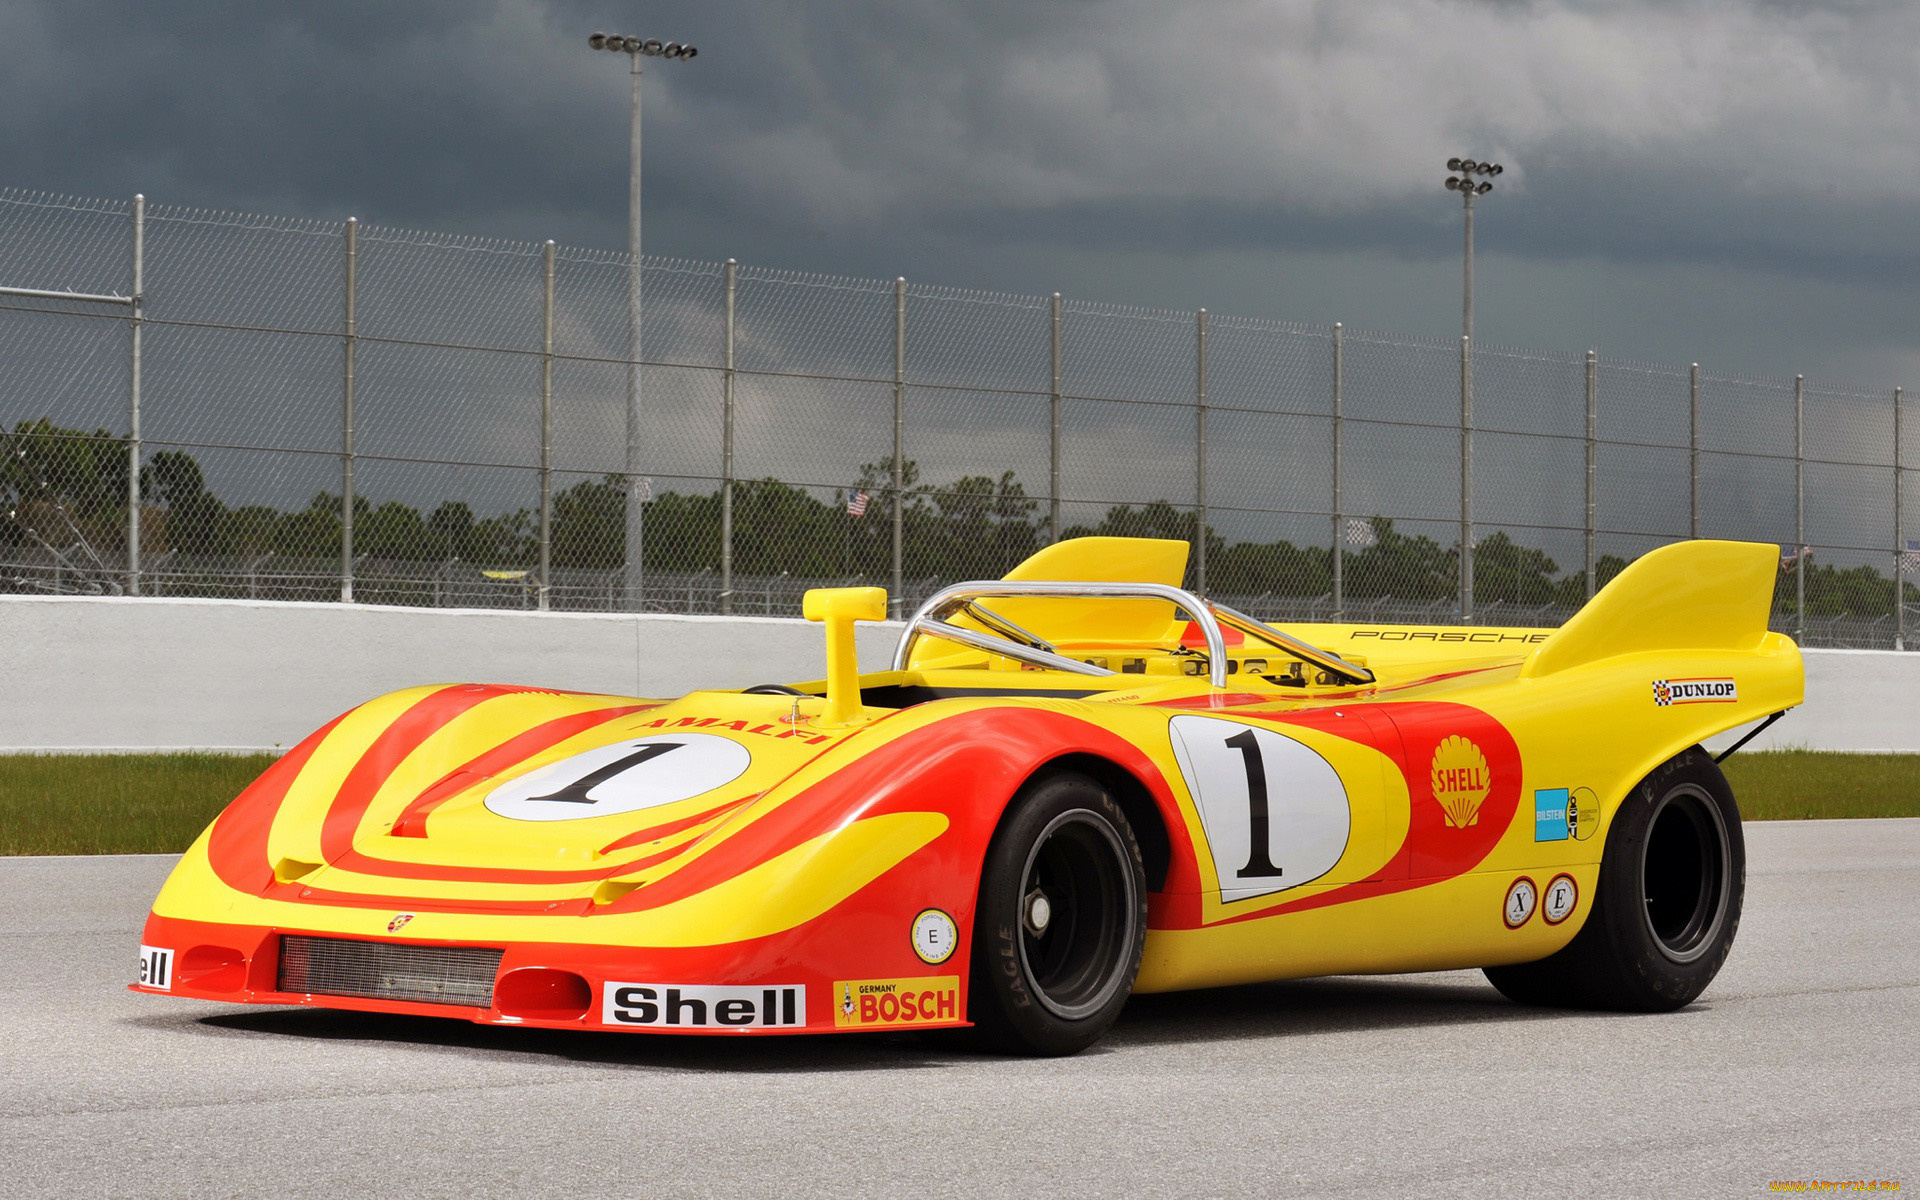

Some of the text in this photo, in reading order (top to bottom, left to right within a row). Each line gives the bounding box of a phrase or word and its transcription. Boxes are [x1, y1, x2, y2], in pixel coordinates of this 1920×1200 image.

[1350, 631, 1550, 644] PORSCHE
[1671, 683, 1735, 698] DUNLOP
[628, 716, 833, 745] AMALFI
[525, 742, 688, 804] 1
[1437, 767, 1484, 793] SHELL
[1224, 728, 1283, 879] 1
[1536, 809, 1566, 822] BILSTEIN
[1512, 892, 1527, 913] X
[1553, 888, 1566, 910] E
[929, 930, 938, 944] E
[998, 923, 1031, 1009] EAGLE
[859, 984, 897, 993] GERMANY
[614, 987, 796, 1026] Shell
[860, 989, 955, 1023] BOSCH
